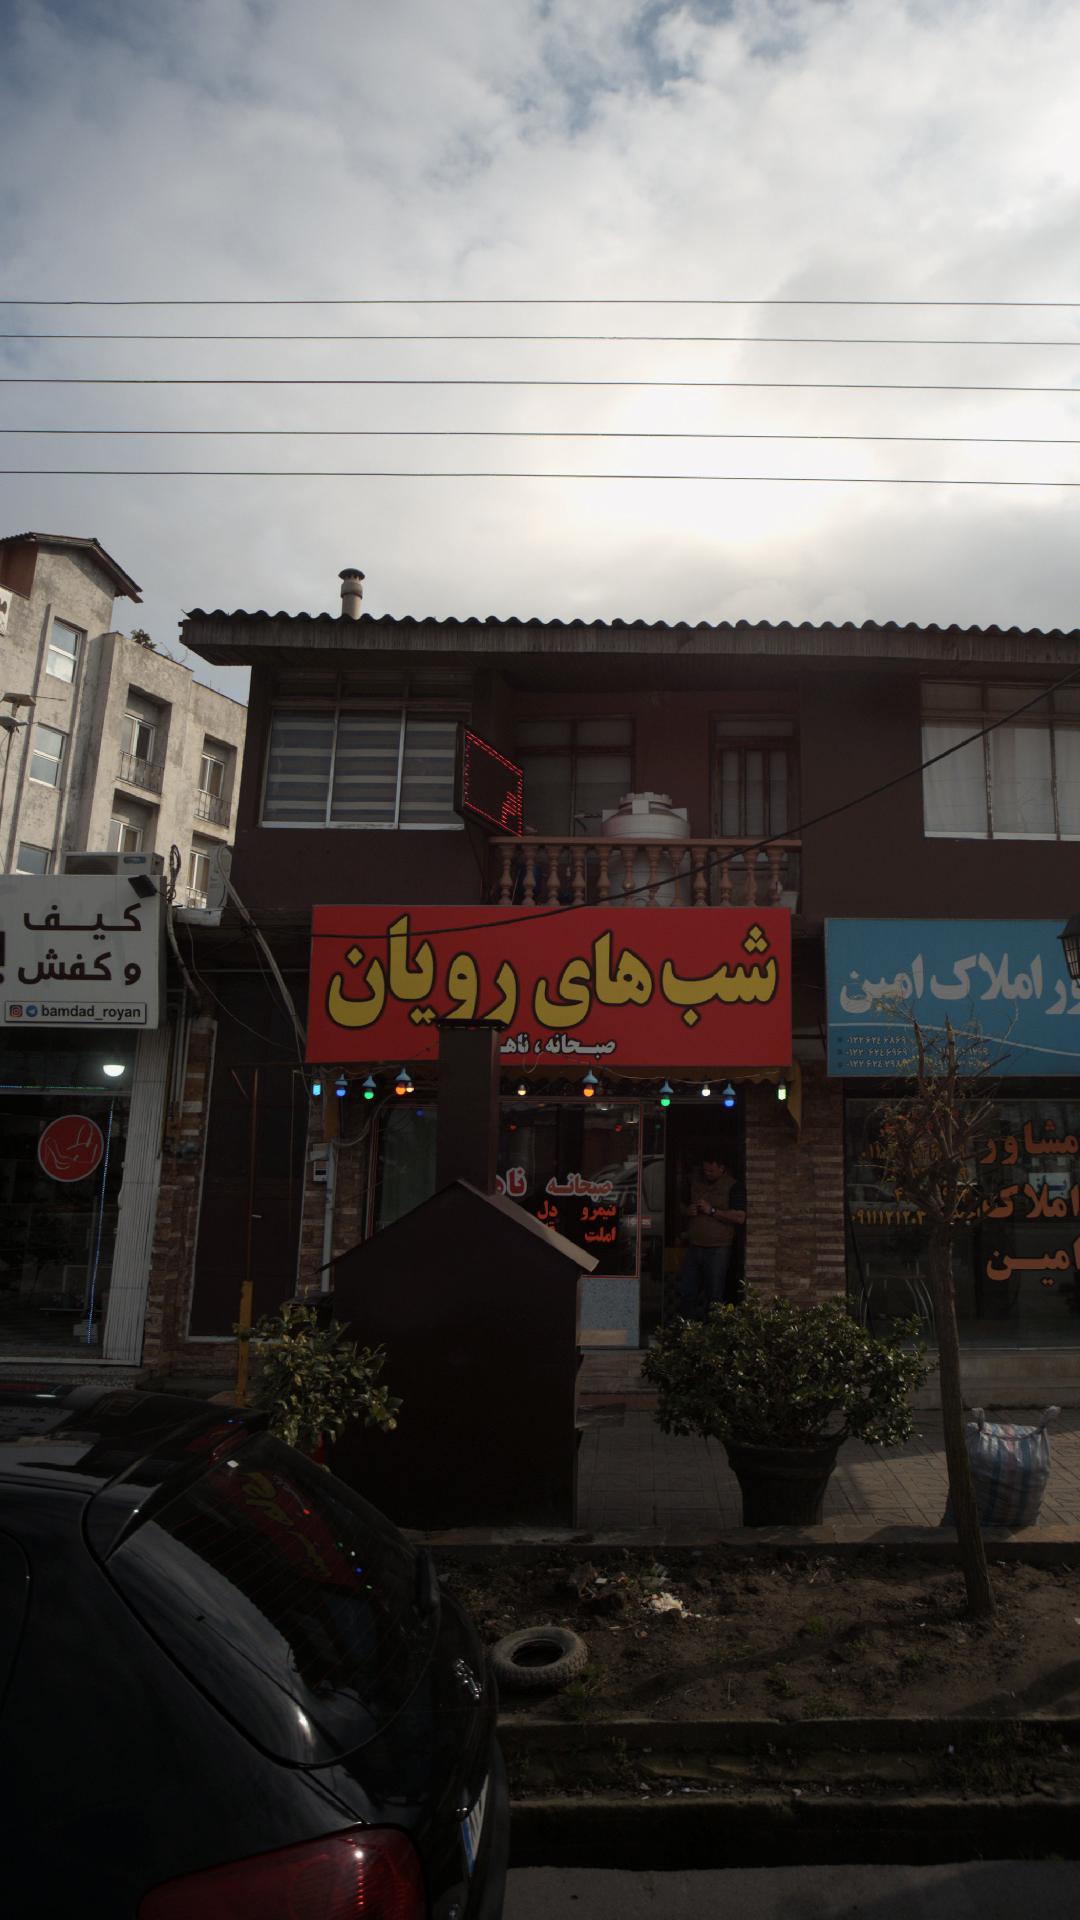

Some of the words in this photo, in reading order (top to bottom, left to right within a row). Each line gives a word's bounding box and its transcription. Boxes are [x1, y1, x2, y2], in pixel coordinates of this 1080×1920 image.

[23, 903, 142, 940] کیف
[18, 949, 112, 985] کفش
[124, 963, 142, 986] و
[326, 913, 516, 1028] رویان
[533, 930, 653, 1029] های
[661, 924, 777, 1028] شب
[839, 953, 924, 1014] امین
[930, 952, 1043, 1000] املاک
[42, 1004, 141, 1021] bamdad_royan
[980, 1119, 1079, 1165] مشاور
[545, 1172, 614, 1201] صبحانه
[981, 1183, 1080, 1219] املاک
[584, 1226, 618, 1243] املت
